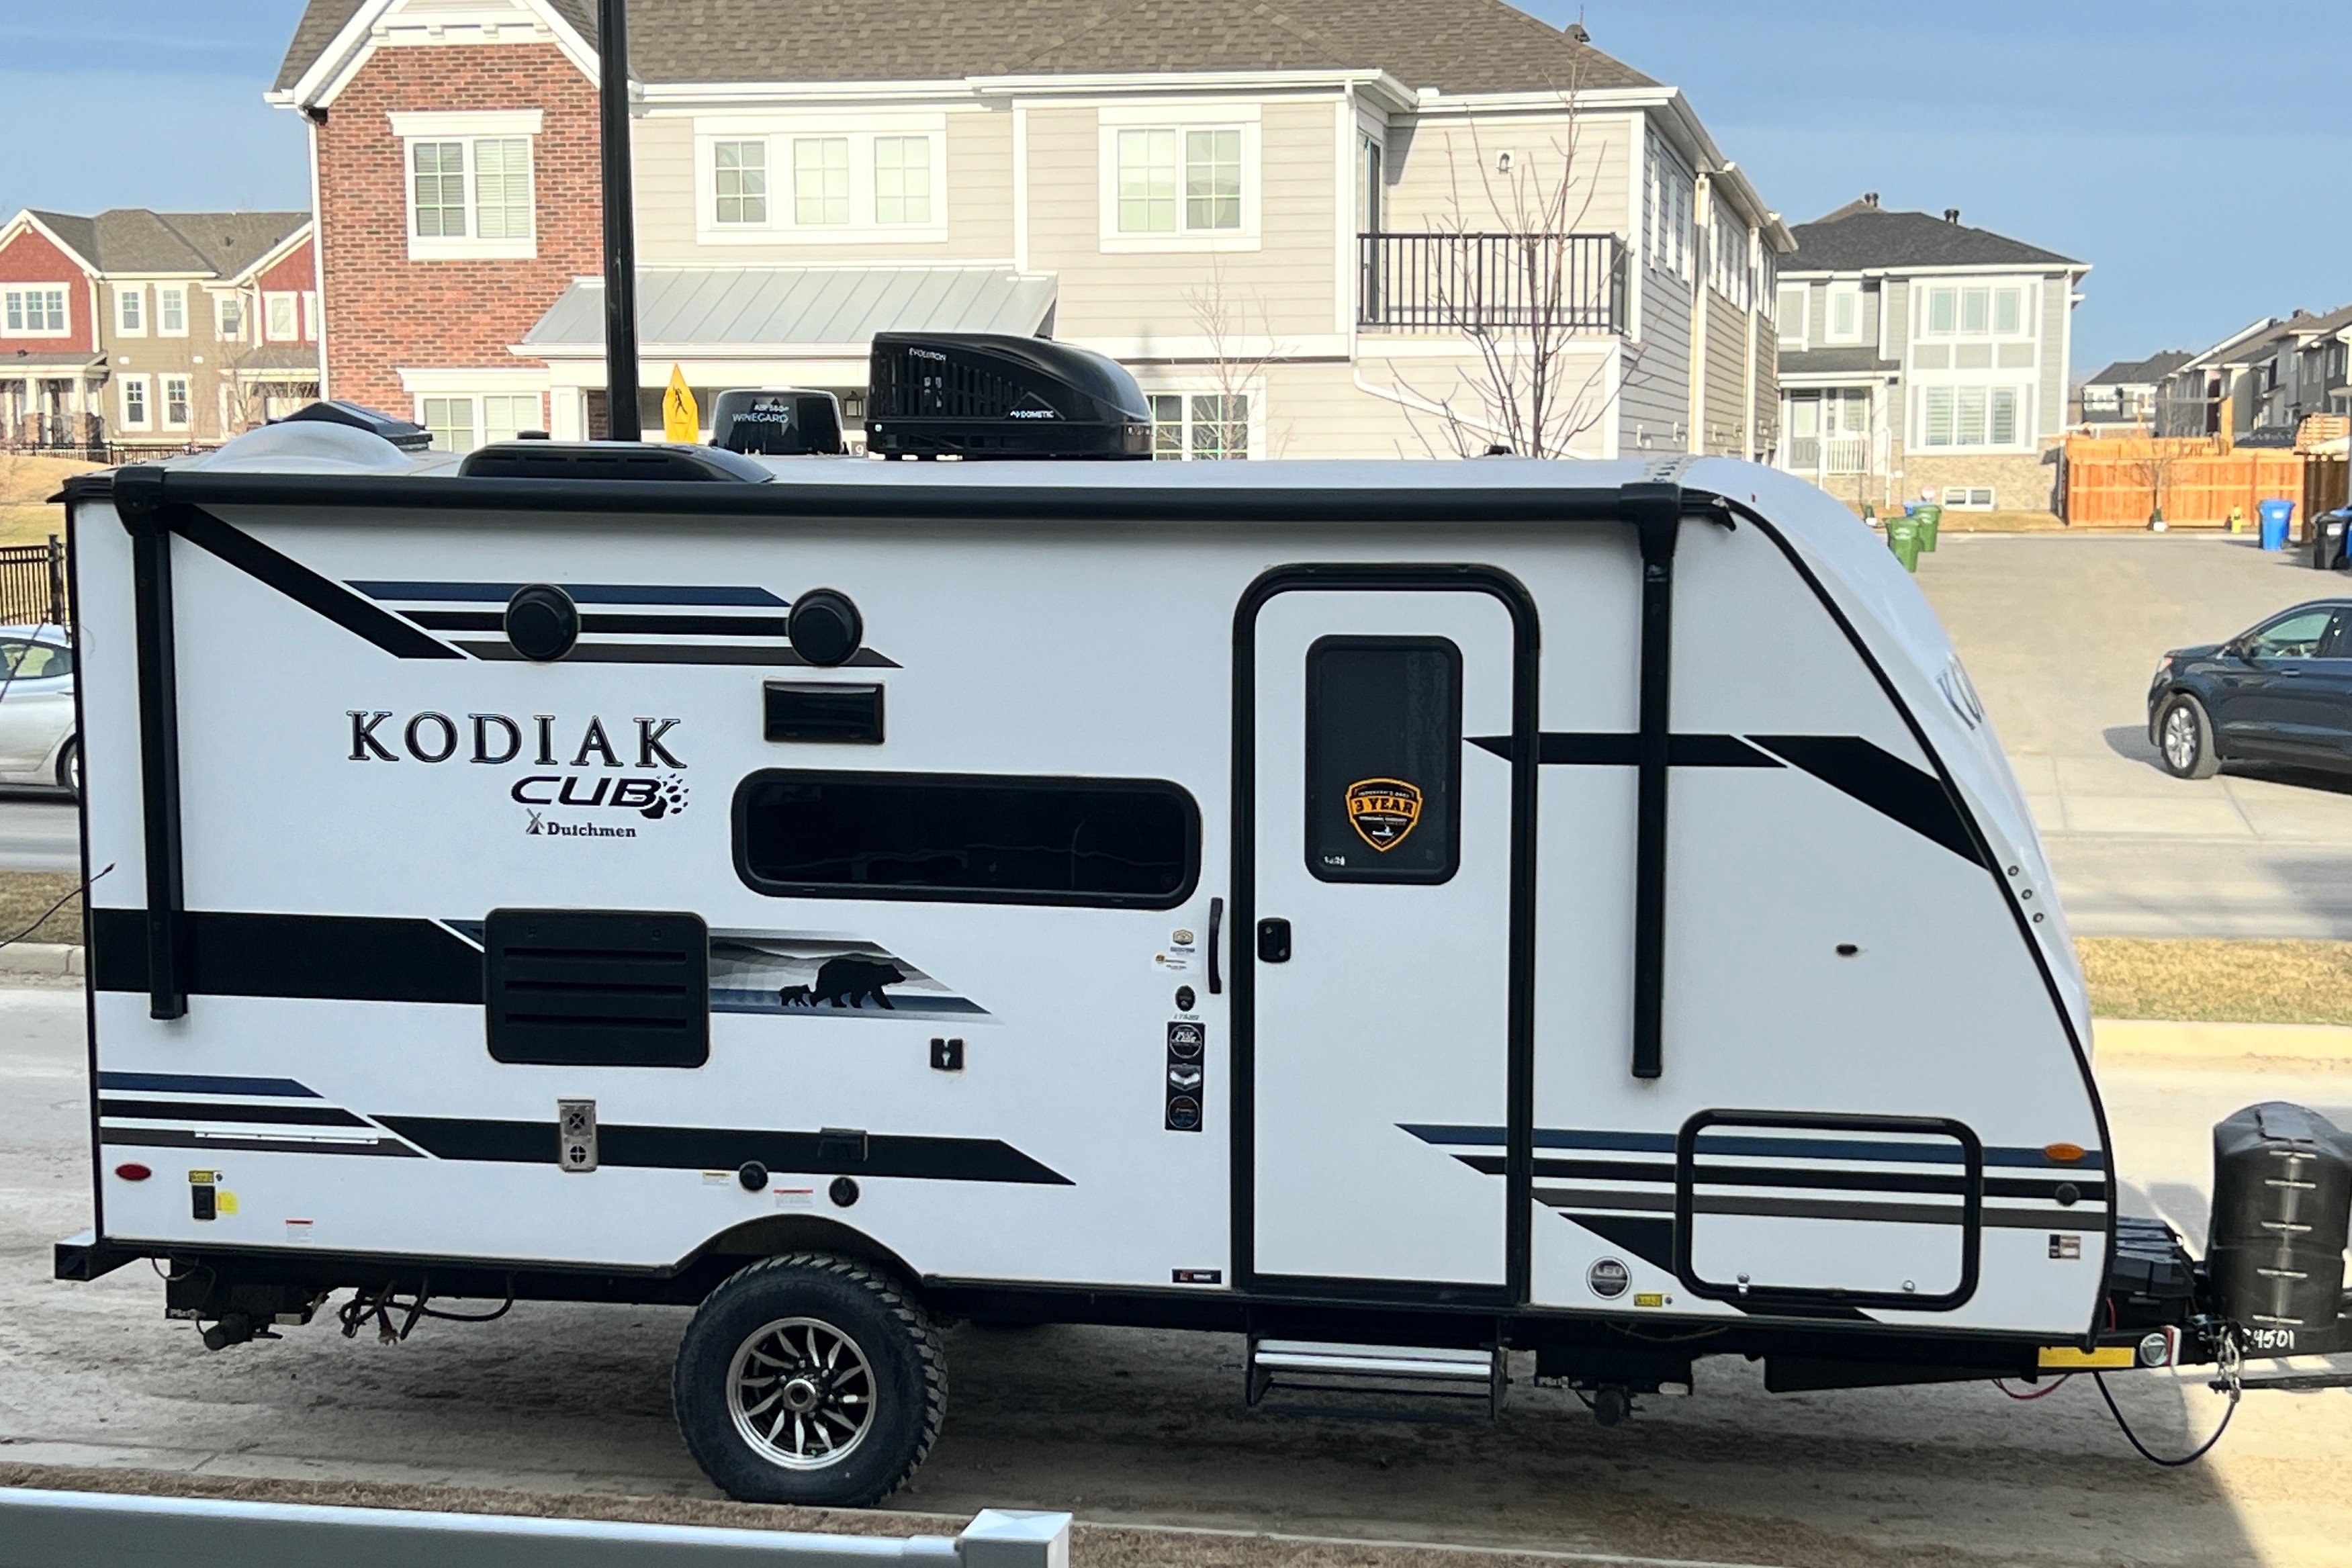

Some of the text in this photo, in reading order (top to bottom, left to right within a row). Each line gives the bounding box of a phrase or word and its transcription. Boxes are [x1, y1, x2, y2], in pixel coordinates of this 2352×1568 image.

[732, 412, 789, 424] WINEGARD
[346, 710, 688, 769] KODIAK
[510, 776, 662, 807] CUB
[1354, 797, 1414, 815] 3 YEAR
[547, 821, 637, 837] Dutchmen
[2243, 1328, 2295, 1350] 4501
